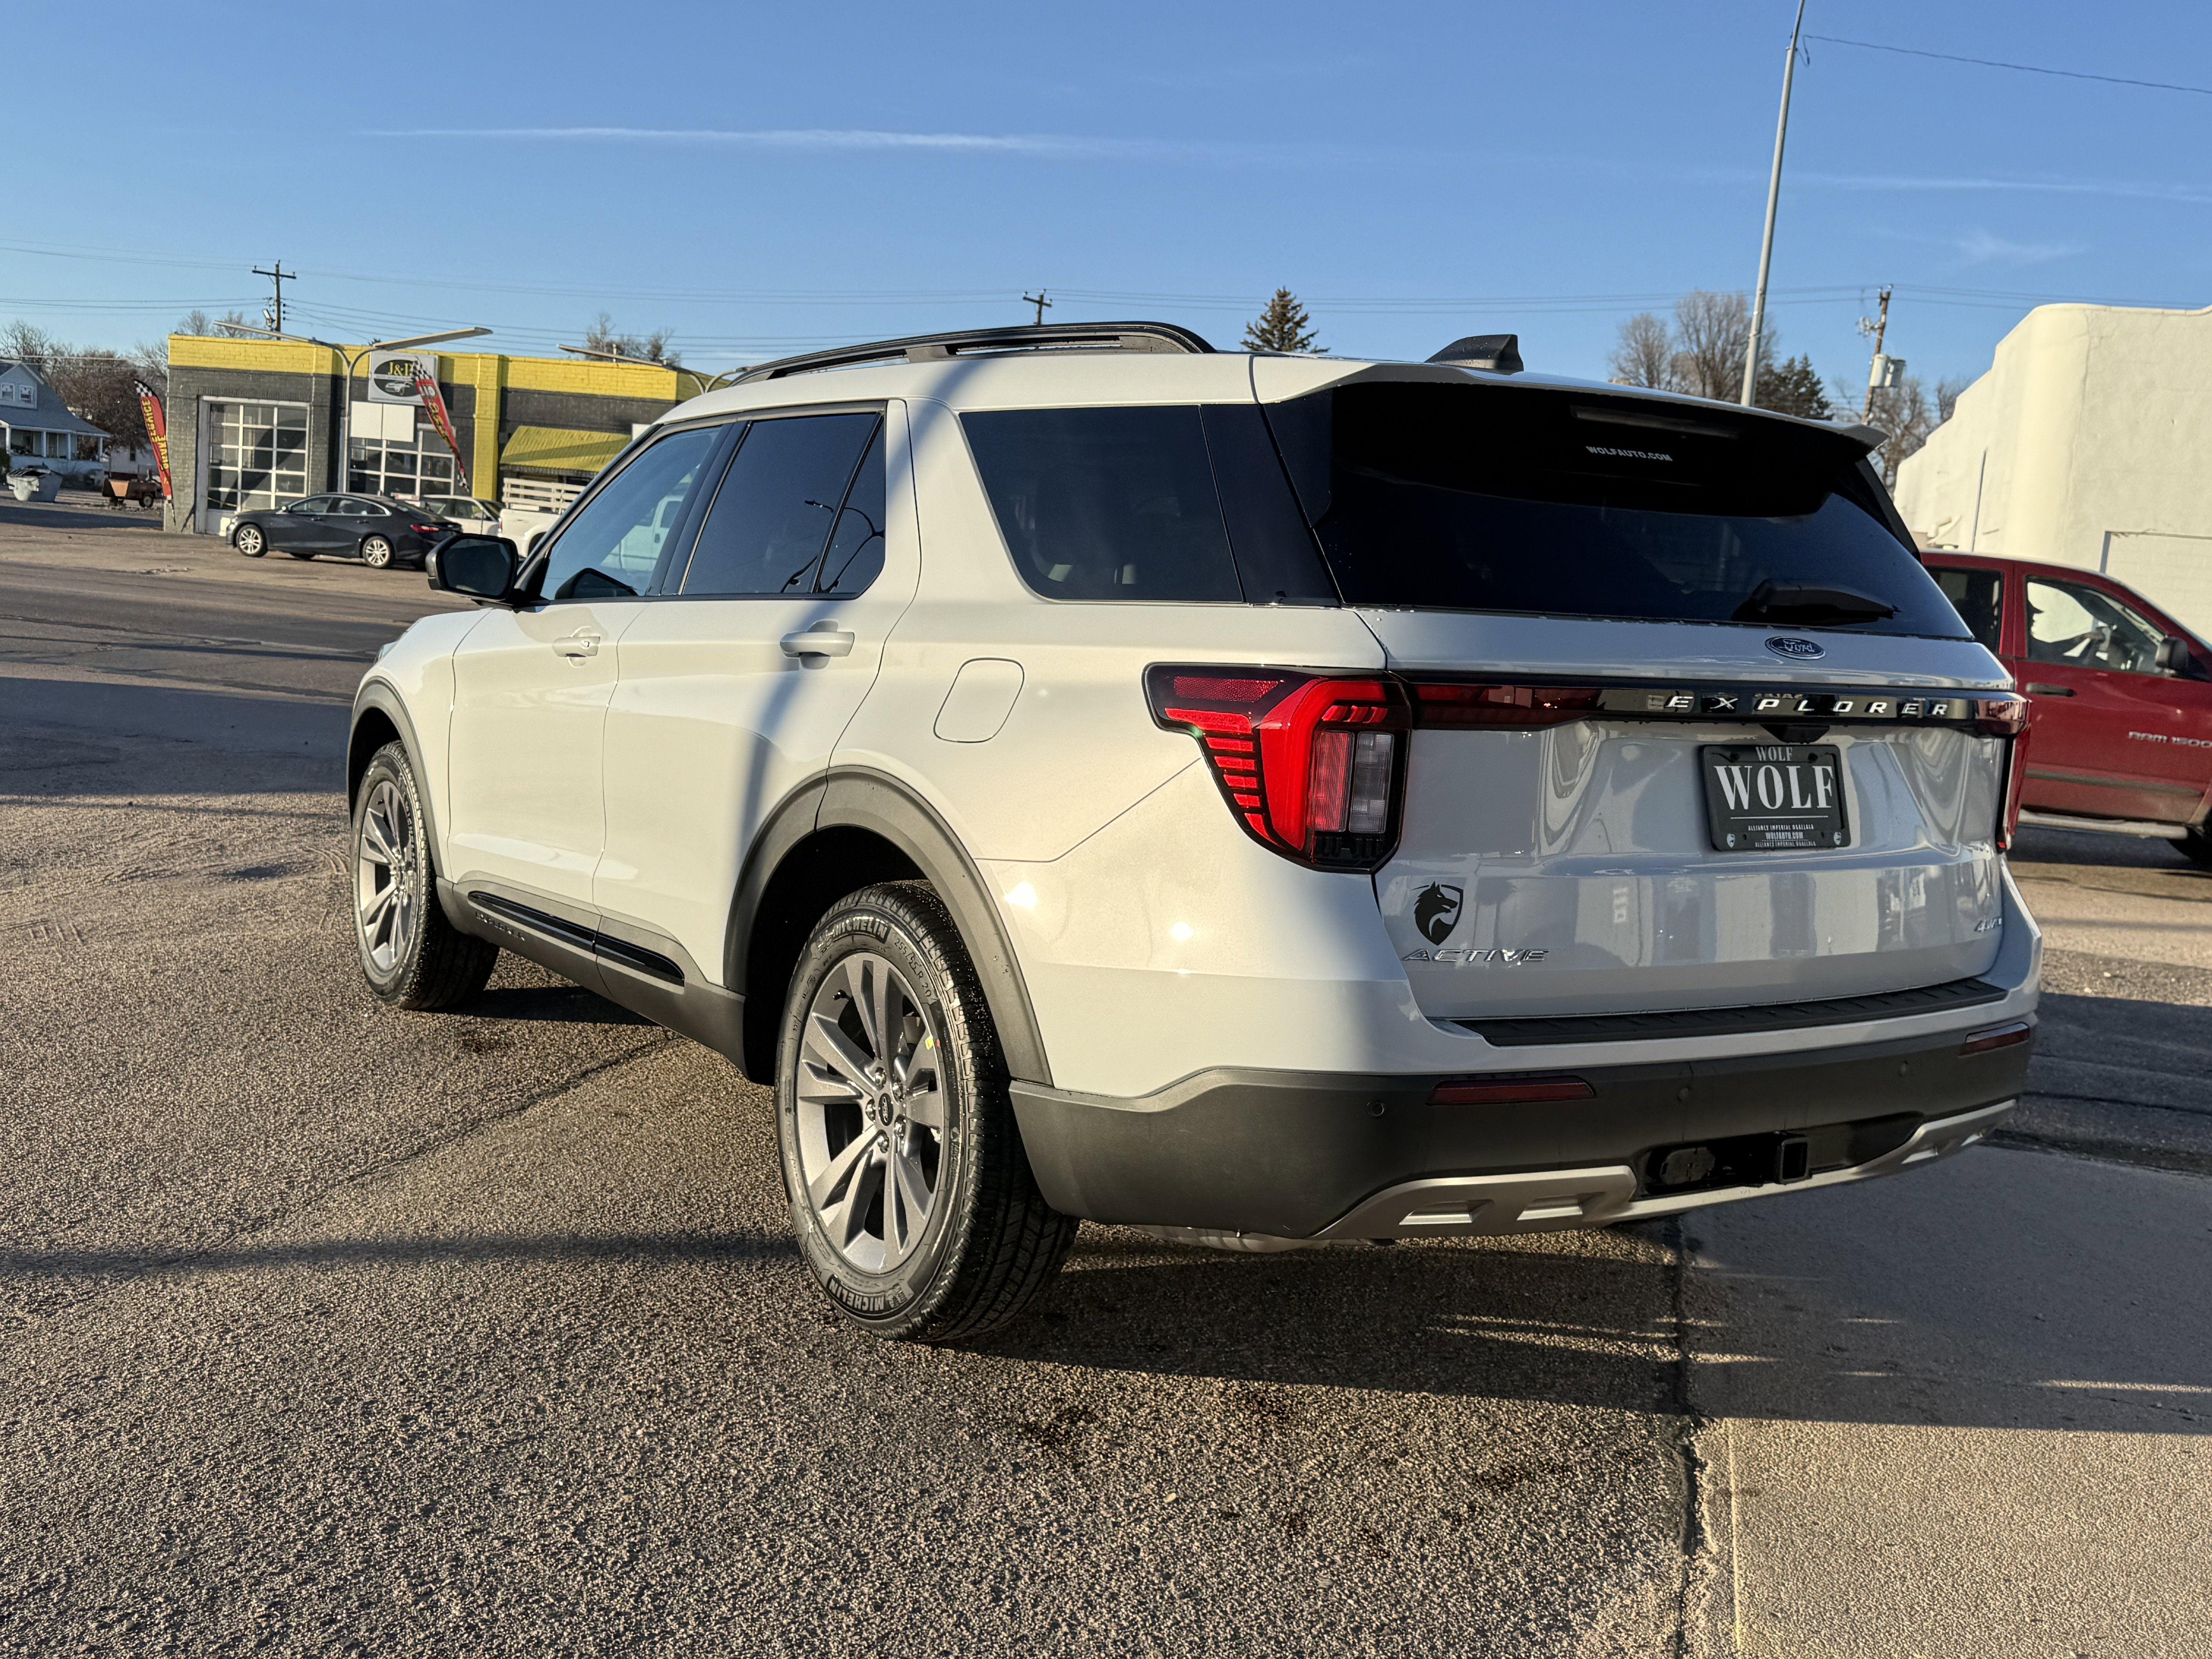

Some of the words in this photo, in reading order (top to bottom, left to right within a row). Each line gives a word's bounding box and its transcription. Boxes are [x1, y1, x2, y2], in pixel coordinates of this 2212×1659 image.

[1586, 446, 1673, 462] WOLFAUTO.COM
[1778, 639, 1815, 653] Ford
[1665, 696, 1948, 716] EXPLORER
[2128, 731, 2167, 743] RAM
[1755, 746, 1793, 761] WOLF
[1714, 765, 1834, 810] WOLF
[1401, 948, 1549, 962] ACTIVE
[828, 1278, 885, 1311] MICHELIN
